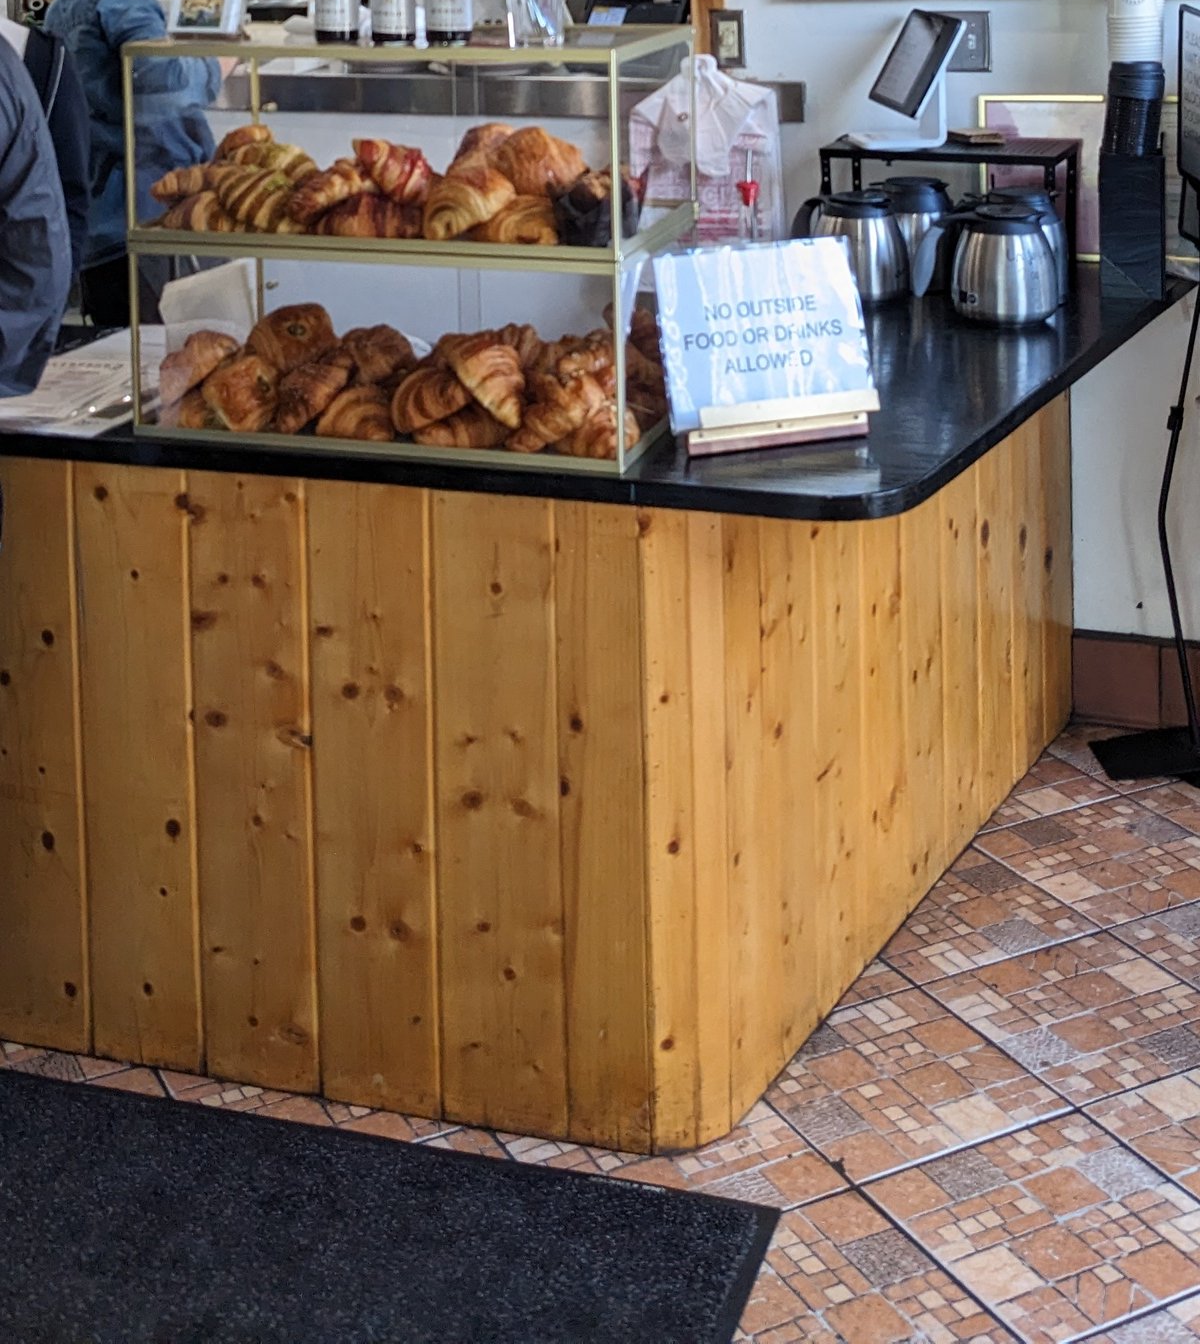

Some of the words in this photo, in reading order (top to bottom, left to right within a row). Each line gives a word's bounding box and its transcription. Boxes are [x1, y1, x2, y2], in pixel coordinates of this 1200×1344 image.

[704, 302, 731, 321] NO
[736, 295, 818, 318] OUTSIDE
[684, 332, 738, 351] FOOD
[742, 326, 768, 345] OR
